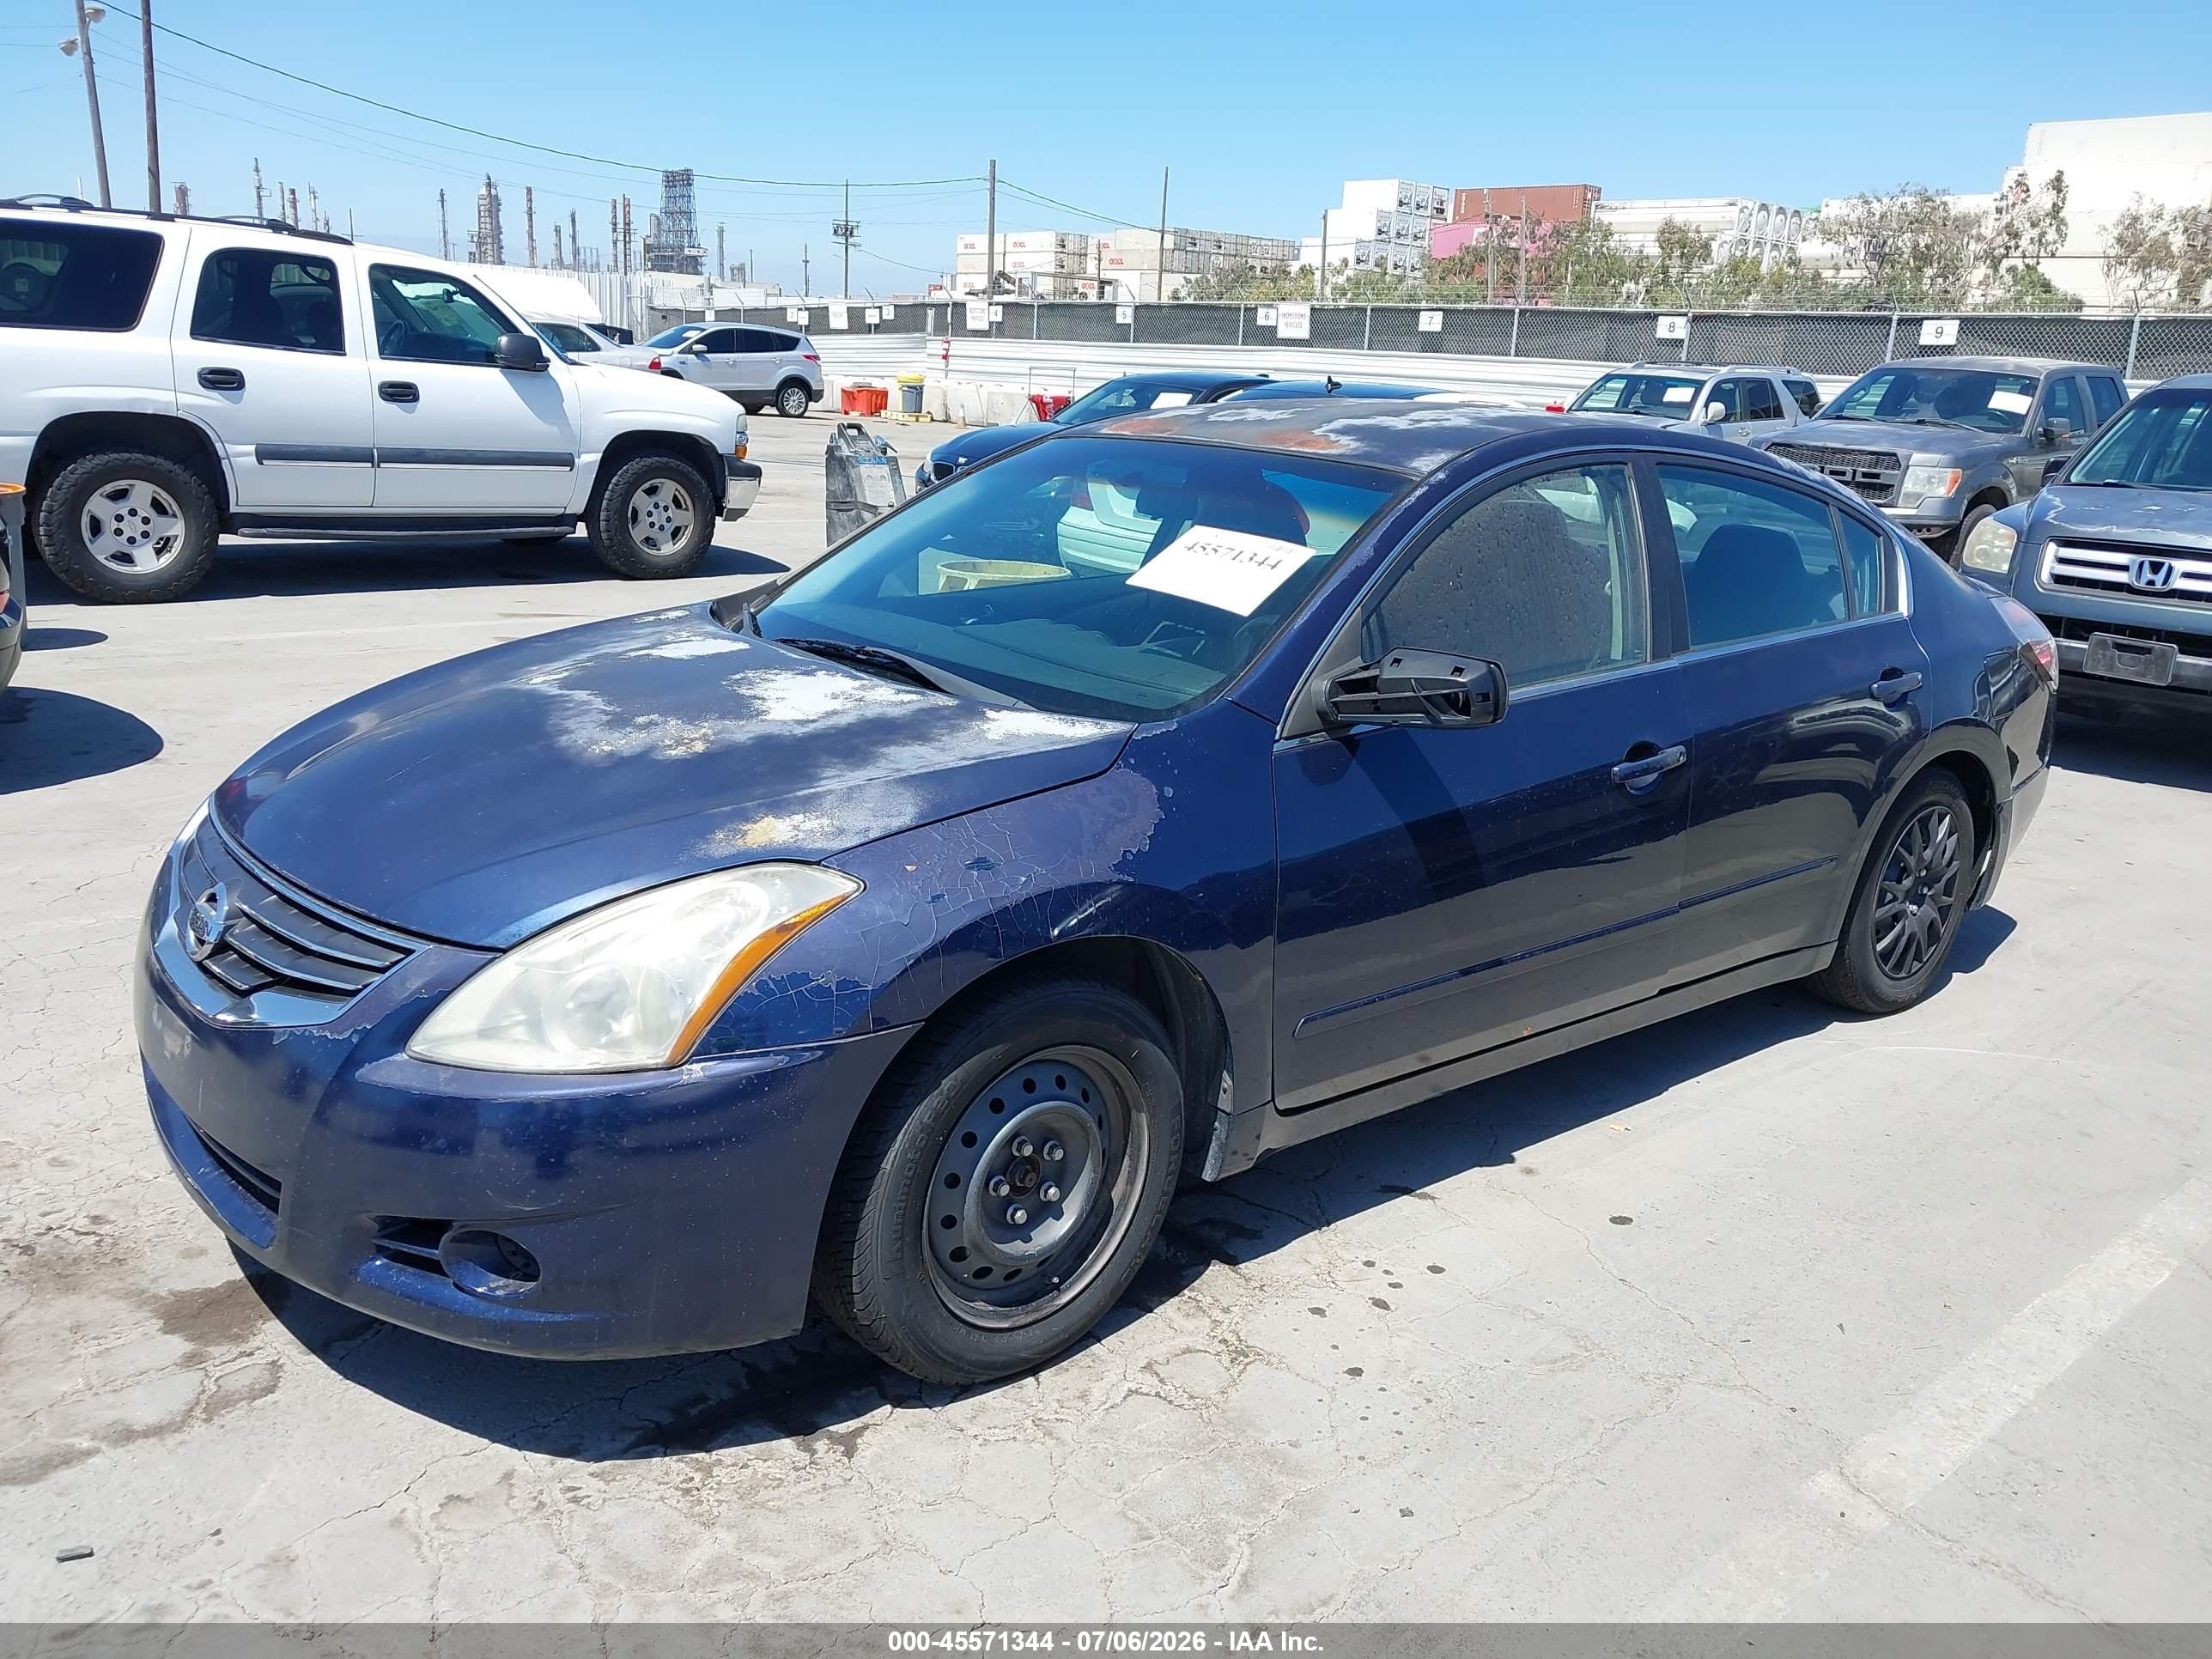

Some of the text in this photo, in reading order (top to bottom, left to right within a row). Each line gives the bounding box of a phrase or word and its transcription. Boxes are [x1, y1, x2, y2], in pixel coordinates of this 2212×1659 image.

[1121, 310, 1127, 319] 5
[1264, 311, 1271, 321] 6
[1428, 316, 1435, 326] 7
[1668, 321, 1675, 333] 8
[1935, 325, 1944, 338] 9
